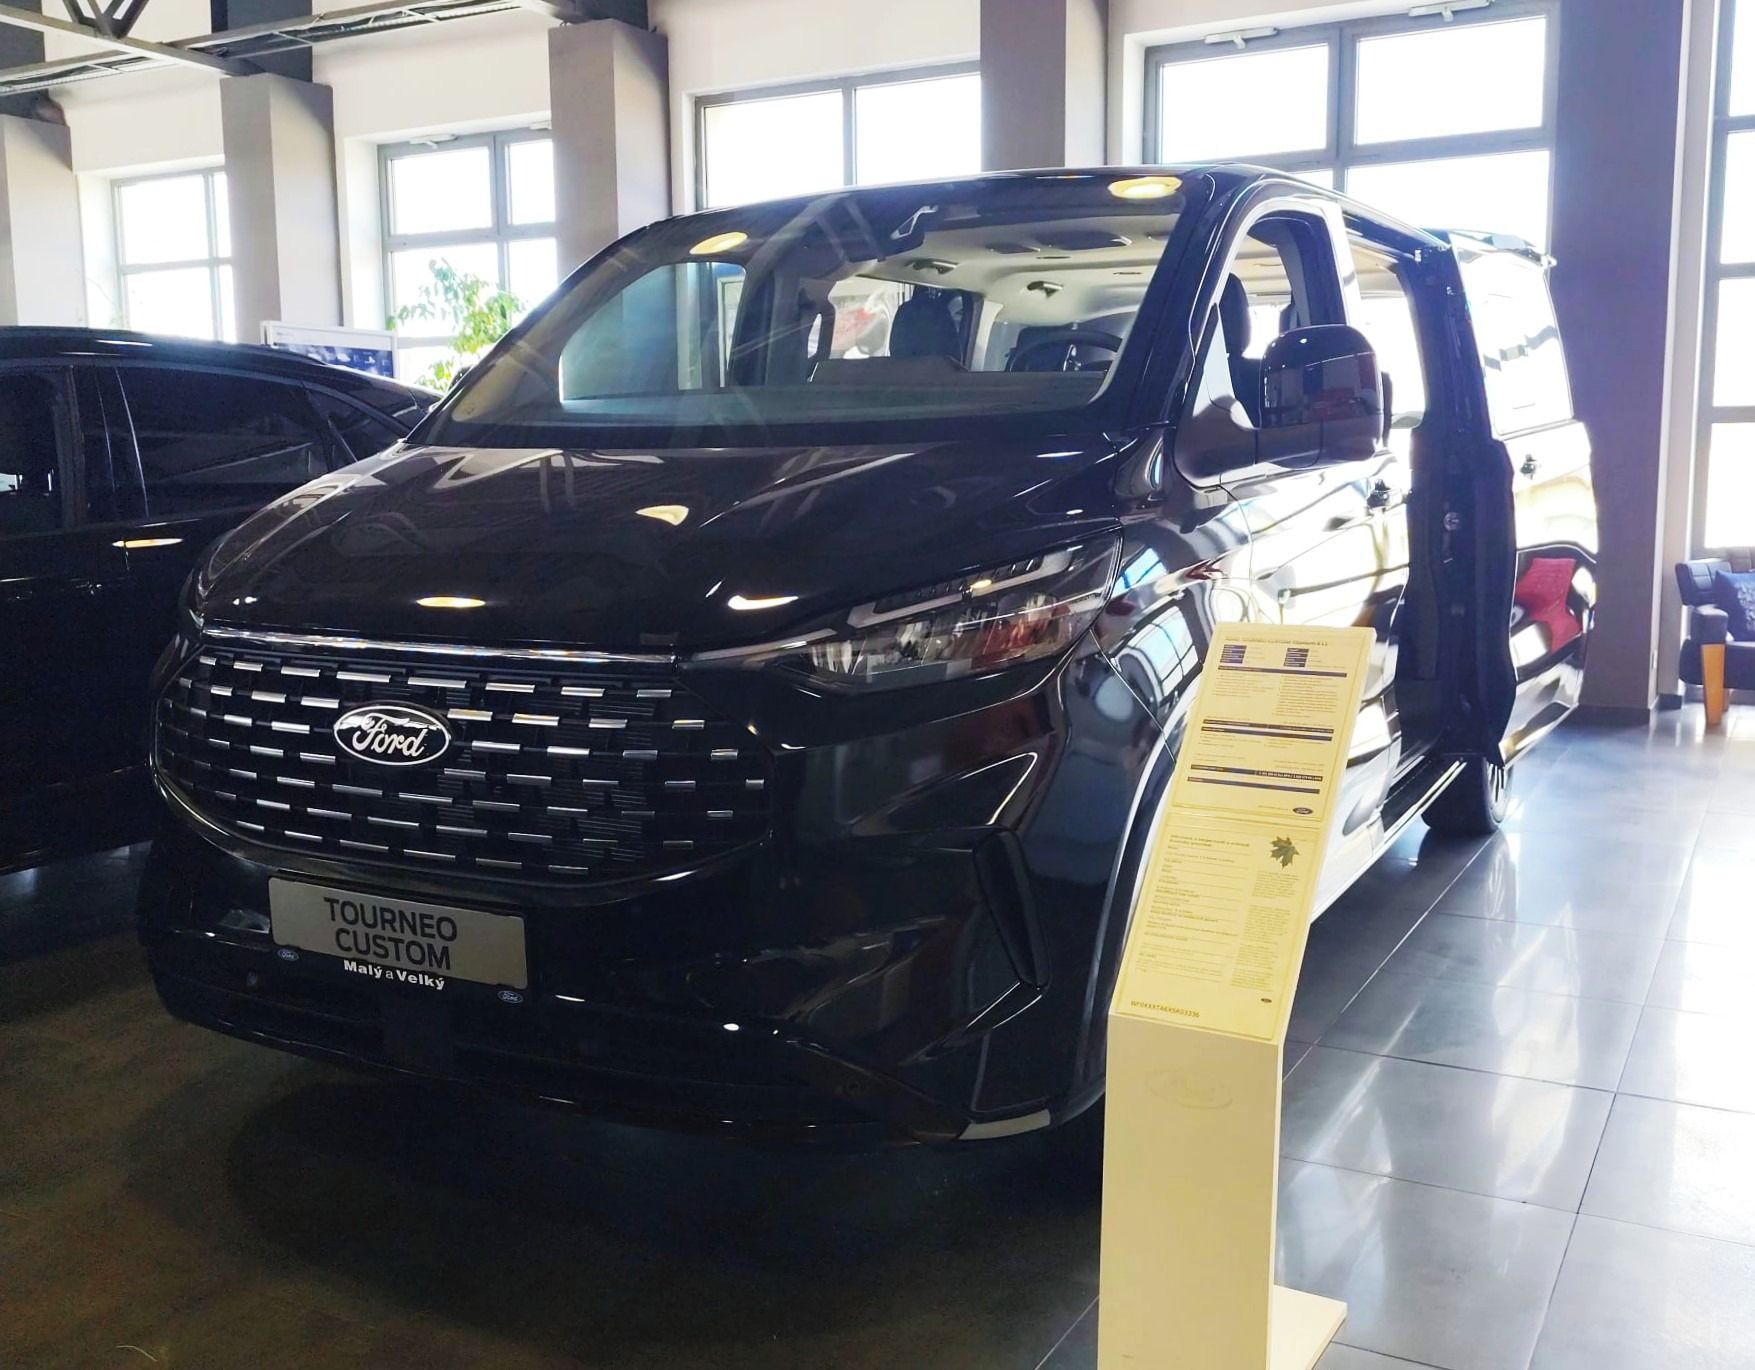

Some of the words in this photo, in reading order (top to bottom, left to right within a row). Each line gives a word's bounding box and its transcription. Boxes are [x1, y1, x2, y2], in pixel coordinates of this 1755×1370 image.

[351, 711, 429, 758] Ford
[323, 897, 457, 942] TOURNEO
[335, 928, 451, 970] CUSTOM
[343, 959, 383, 979] Malý
[385, 970, 394, 980] a
[396, 969, 445, 991] Velký
